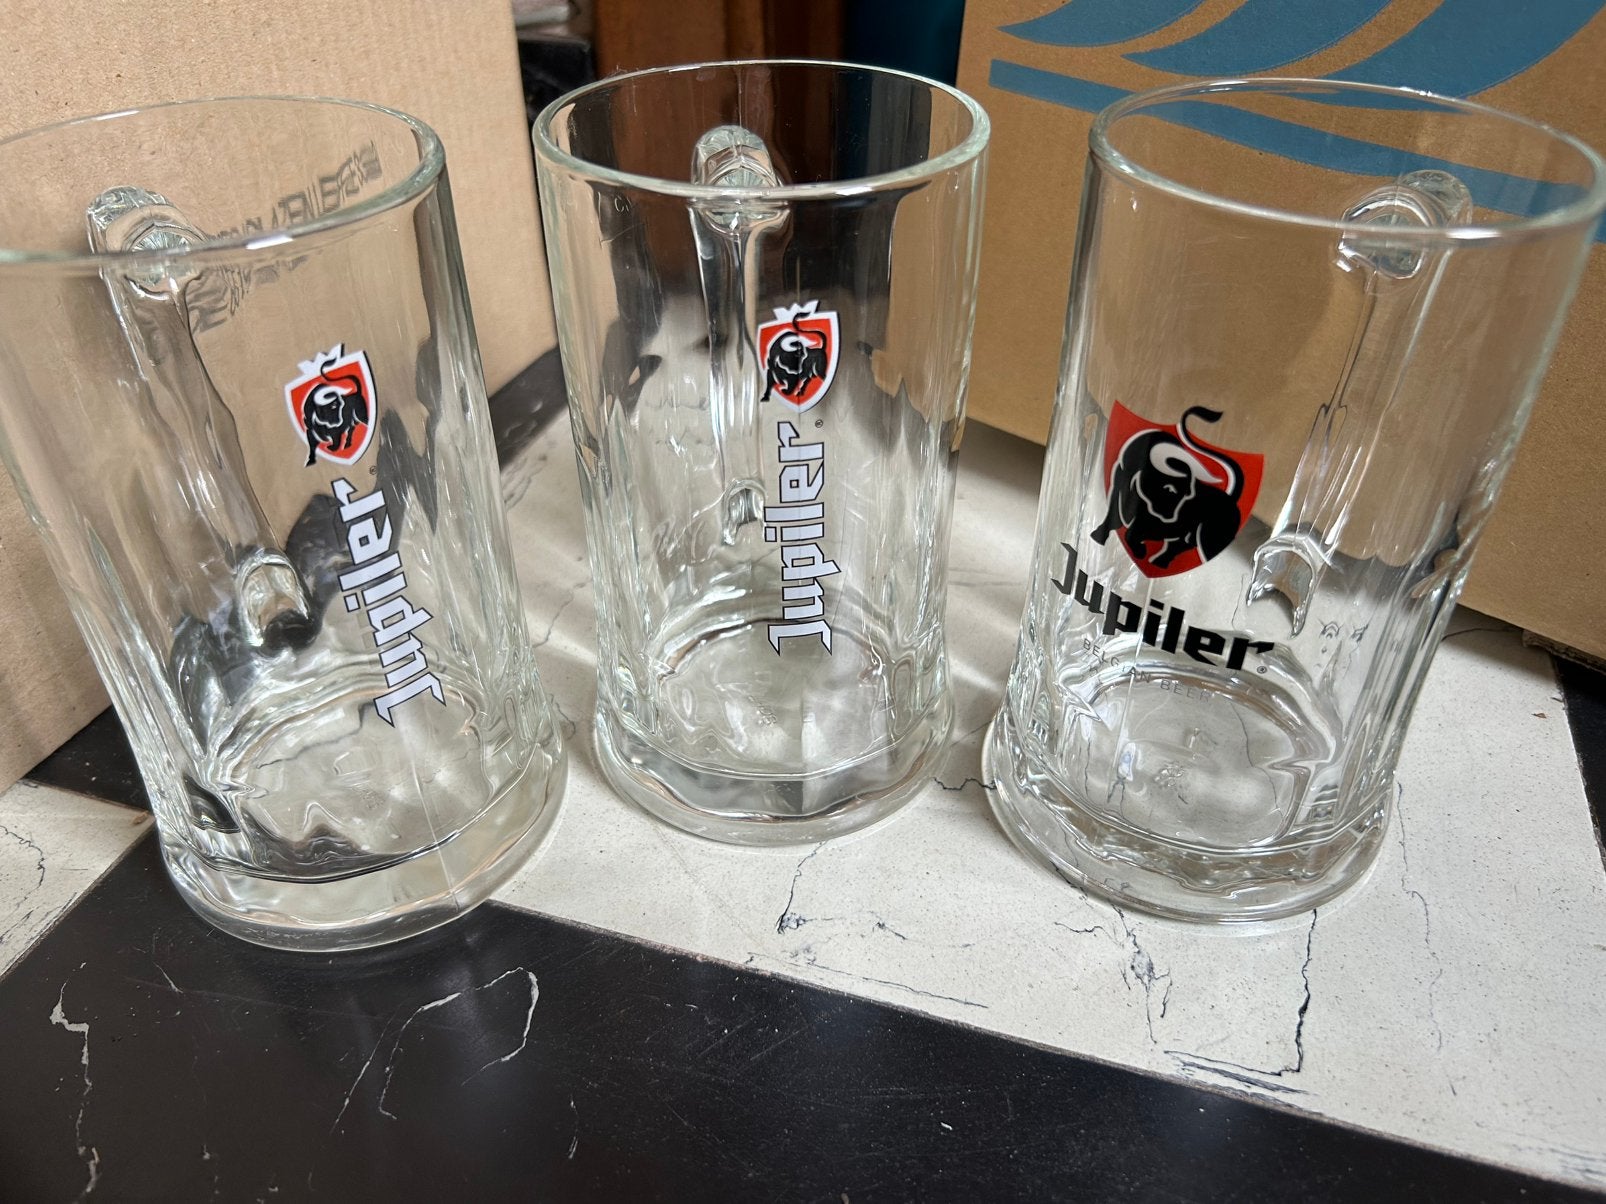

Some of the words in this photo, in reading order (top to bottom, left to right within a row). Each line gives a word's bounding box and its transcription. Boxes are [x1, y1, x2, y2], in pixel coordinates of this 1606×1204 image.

[331, 477, 446, 727] Jupiler
[764, 421, 841, 656] Jupiler
[1050, 542, 1274, 671] Jupiler
[1160, 679, 1211, 702] BEER
